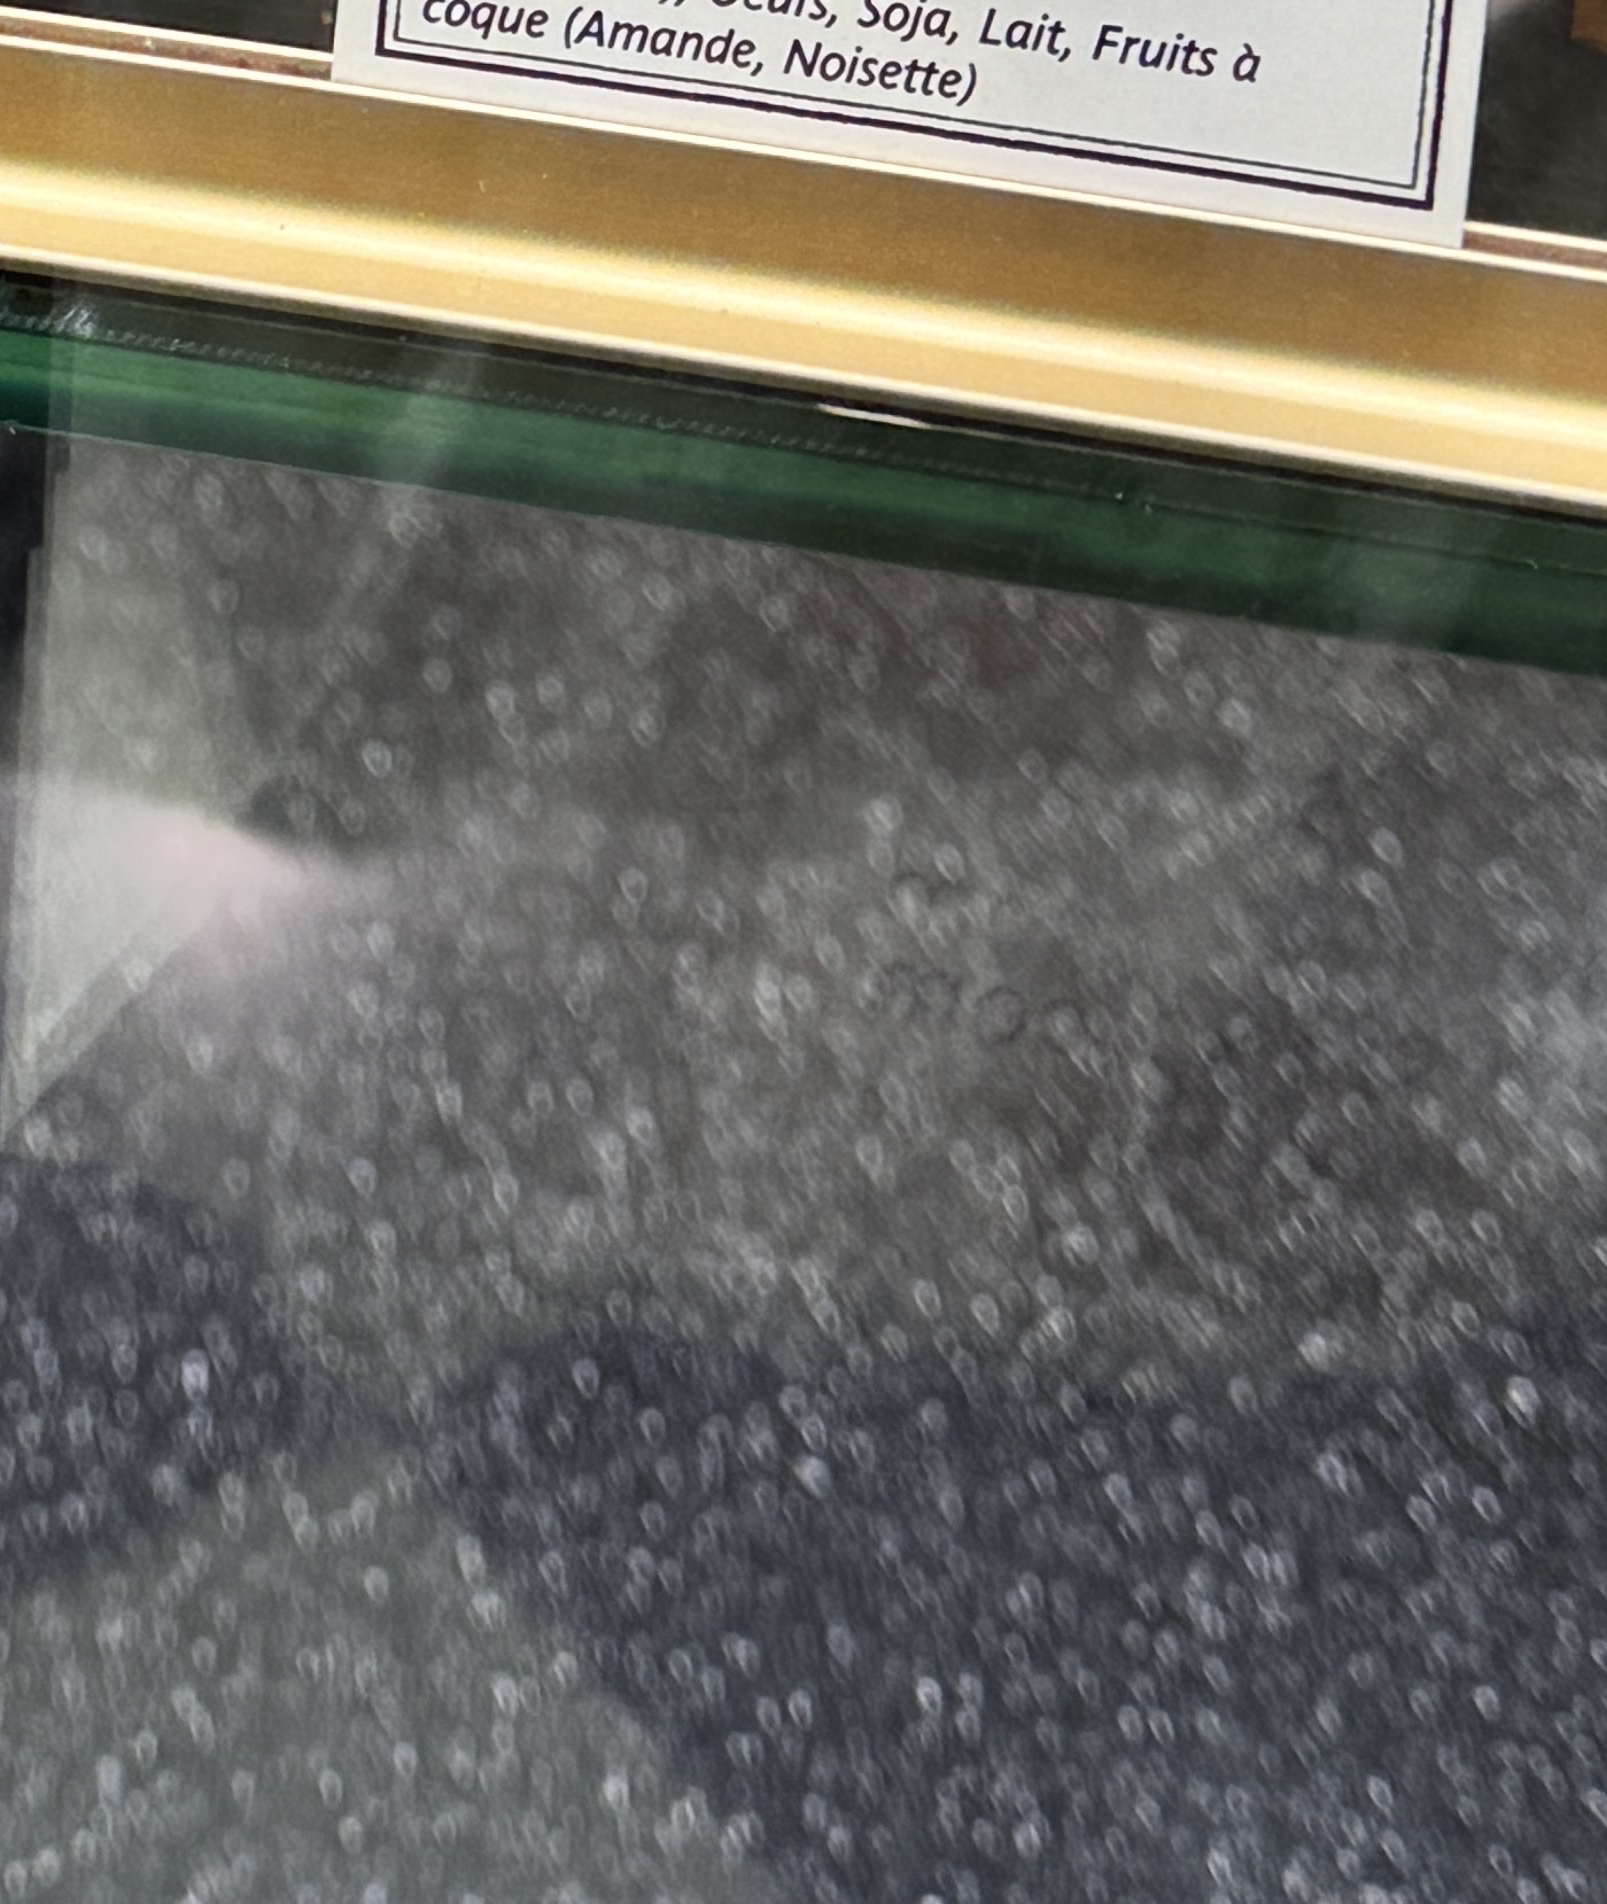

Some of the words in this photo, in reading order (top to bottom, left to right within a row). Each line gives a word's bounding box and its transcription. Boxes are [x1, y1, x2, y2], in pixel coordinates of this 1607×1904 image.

[563, 5, 765, 78] (Amande,
[782, 37, 978, 108] Noisette)
[978, 6, 1072, 64] Lait,
[1091, 23, 1219, 78] Fruits
[1231, 41, 1262, 84] à
